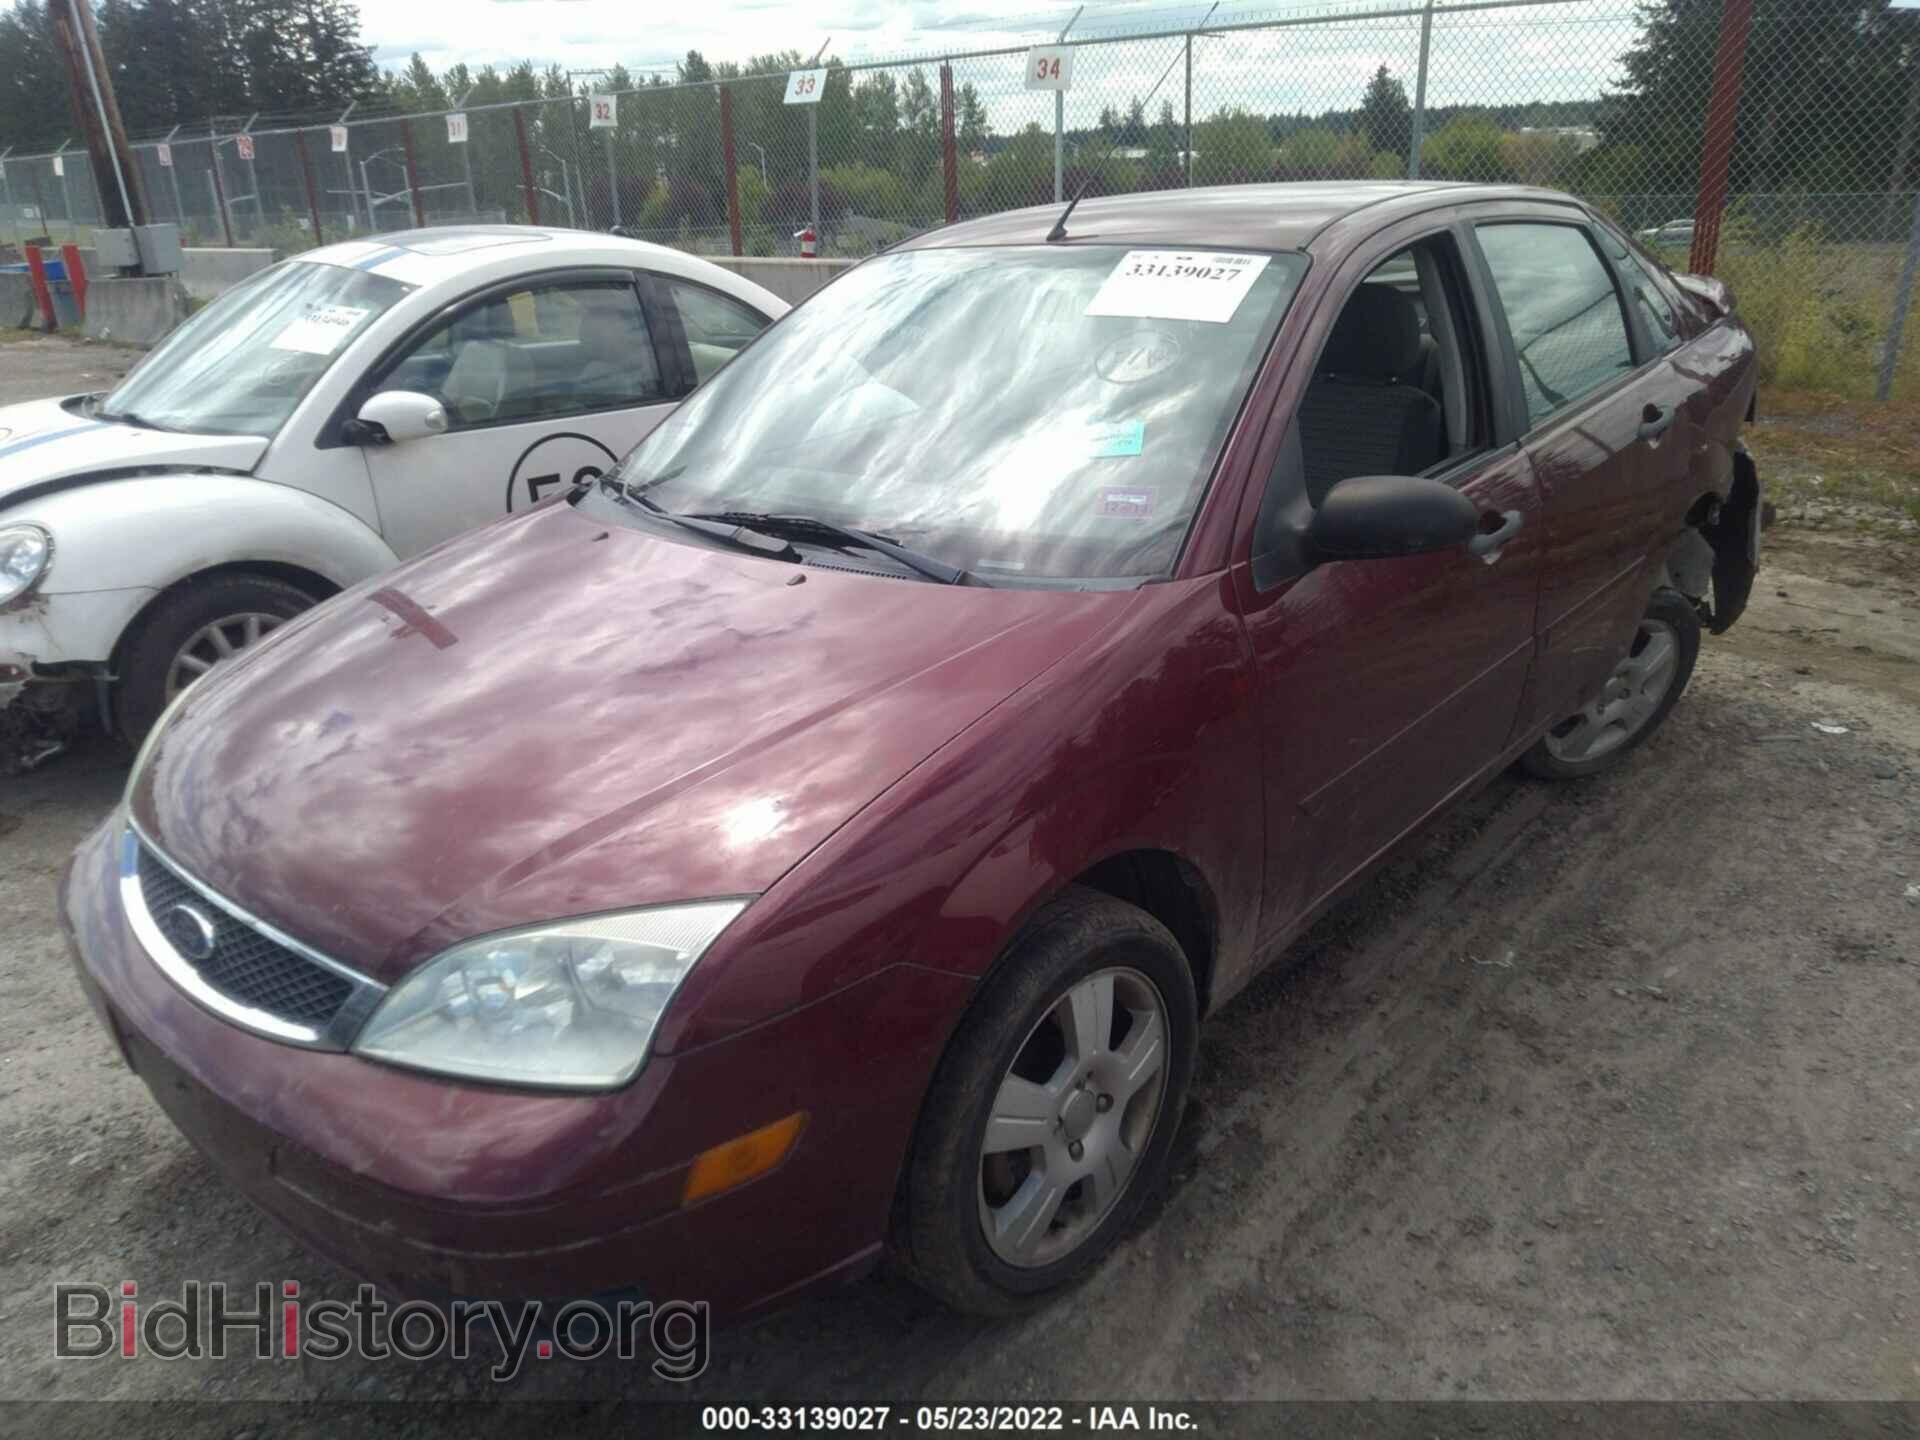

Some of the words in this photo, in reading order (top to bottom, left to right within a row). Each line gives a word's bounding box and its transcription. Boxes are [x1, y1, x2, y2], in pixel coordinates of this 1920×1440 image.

[1036, 58, 1060, 80] 34
[794, 78, 816, 95] 33
[594, 102, 611, 120] 32
[1125, 263, 1242, 281] 33139027
